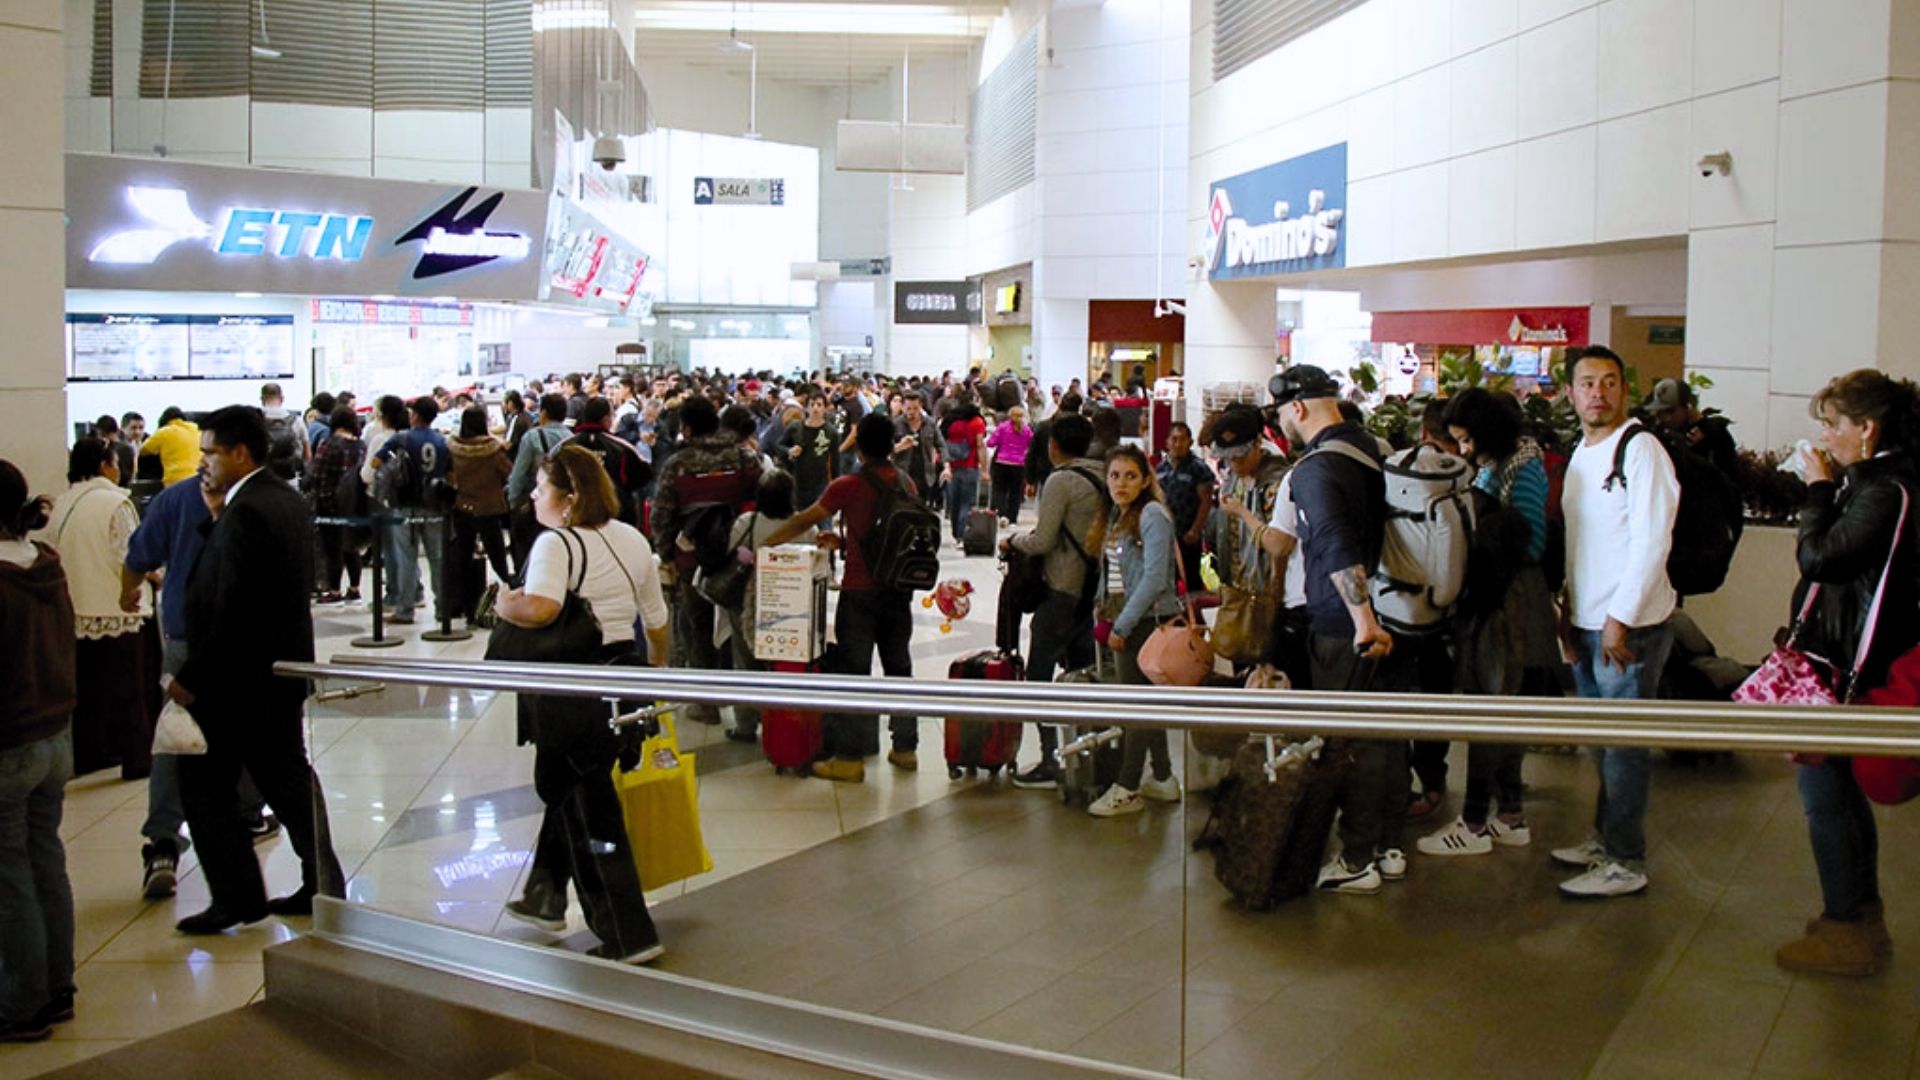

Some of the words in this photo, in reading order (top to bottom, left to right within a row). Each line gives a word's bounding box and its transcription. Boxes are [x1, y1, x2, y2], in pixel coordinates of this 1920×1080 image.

[695, 181, 713, 199] A
[717, 183, 751, 198] SALA
[214, 207, 375, 262] ETN
[421, 442, 437, 472] 9
